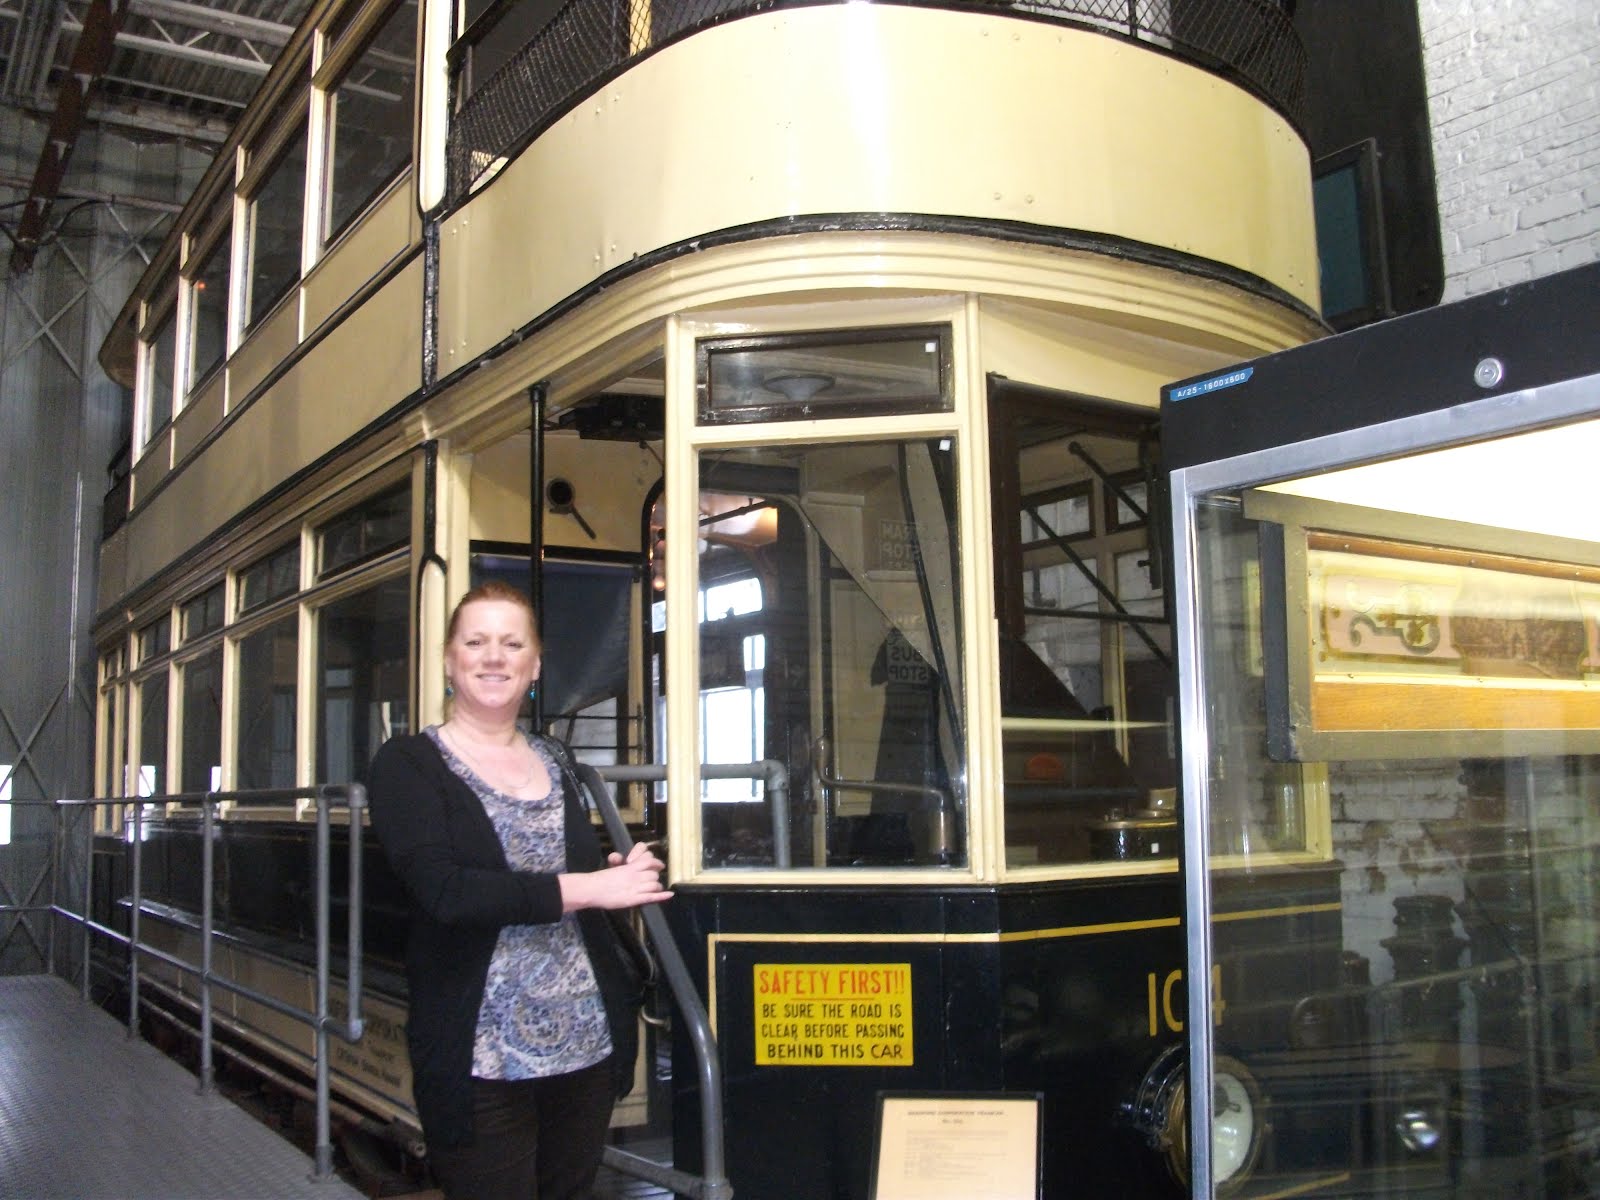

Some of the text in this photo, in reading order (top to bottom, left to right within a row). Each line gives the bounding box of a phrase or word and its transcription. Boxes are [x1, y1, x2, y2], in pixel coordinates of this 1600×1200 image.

[759, 970, 905, 994] SAFETY FIRST!!
[762, 1003, 902, 1018] BE SURE THE ROAD IS
[761, 1024, 905, 1040] CLEAR BEFORE PASSING
[767, 1043, 903, 1059] BEHIND THIS CAR
